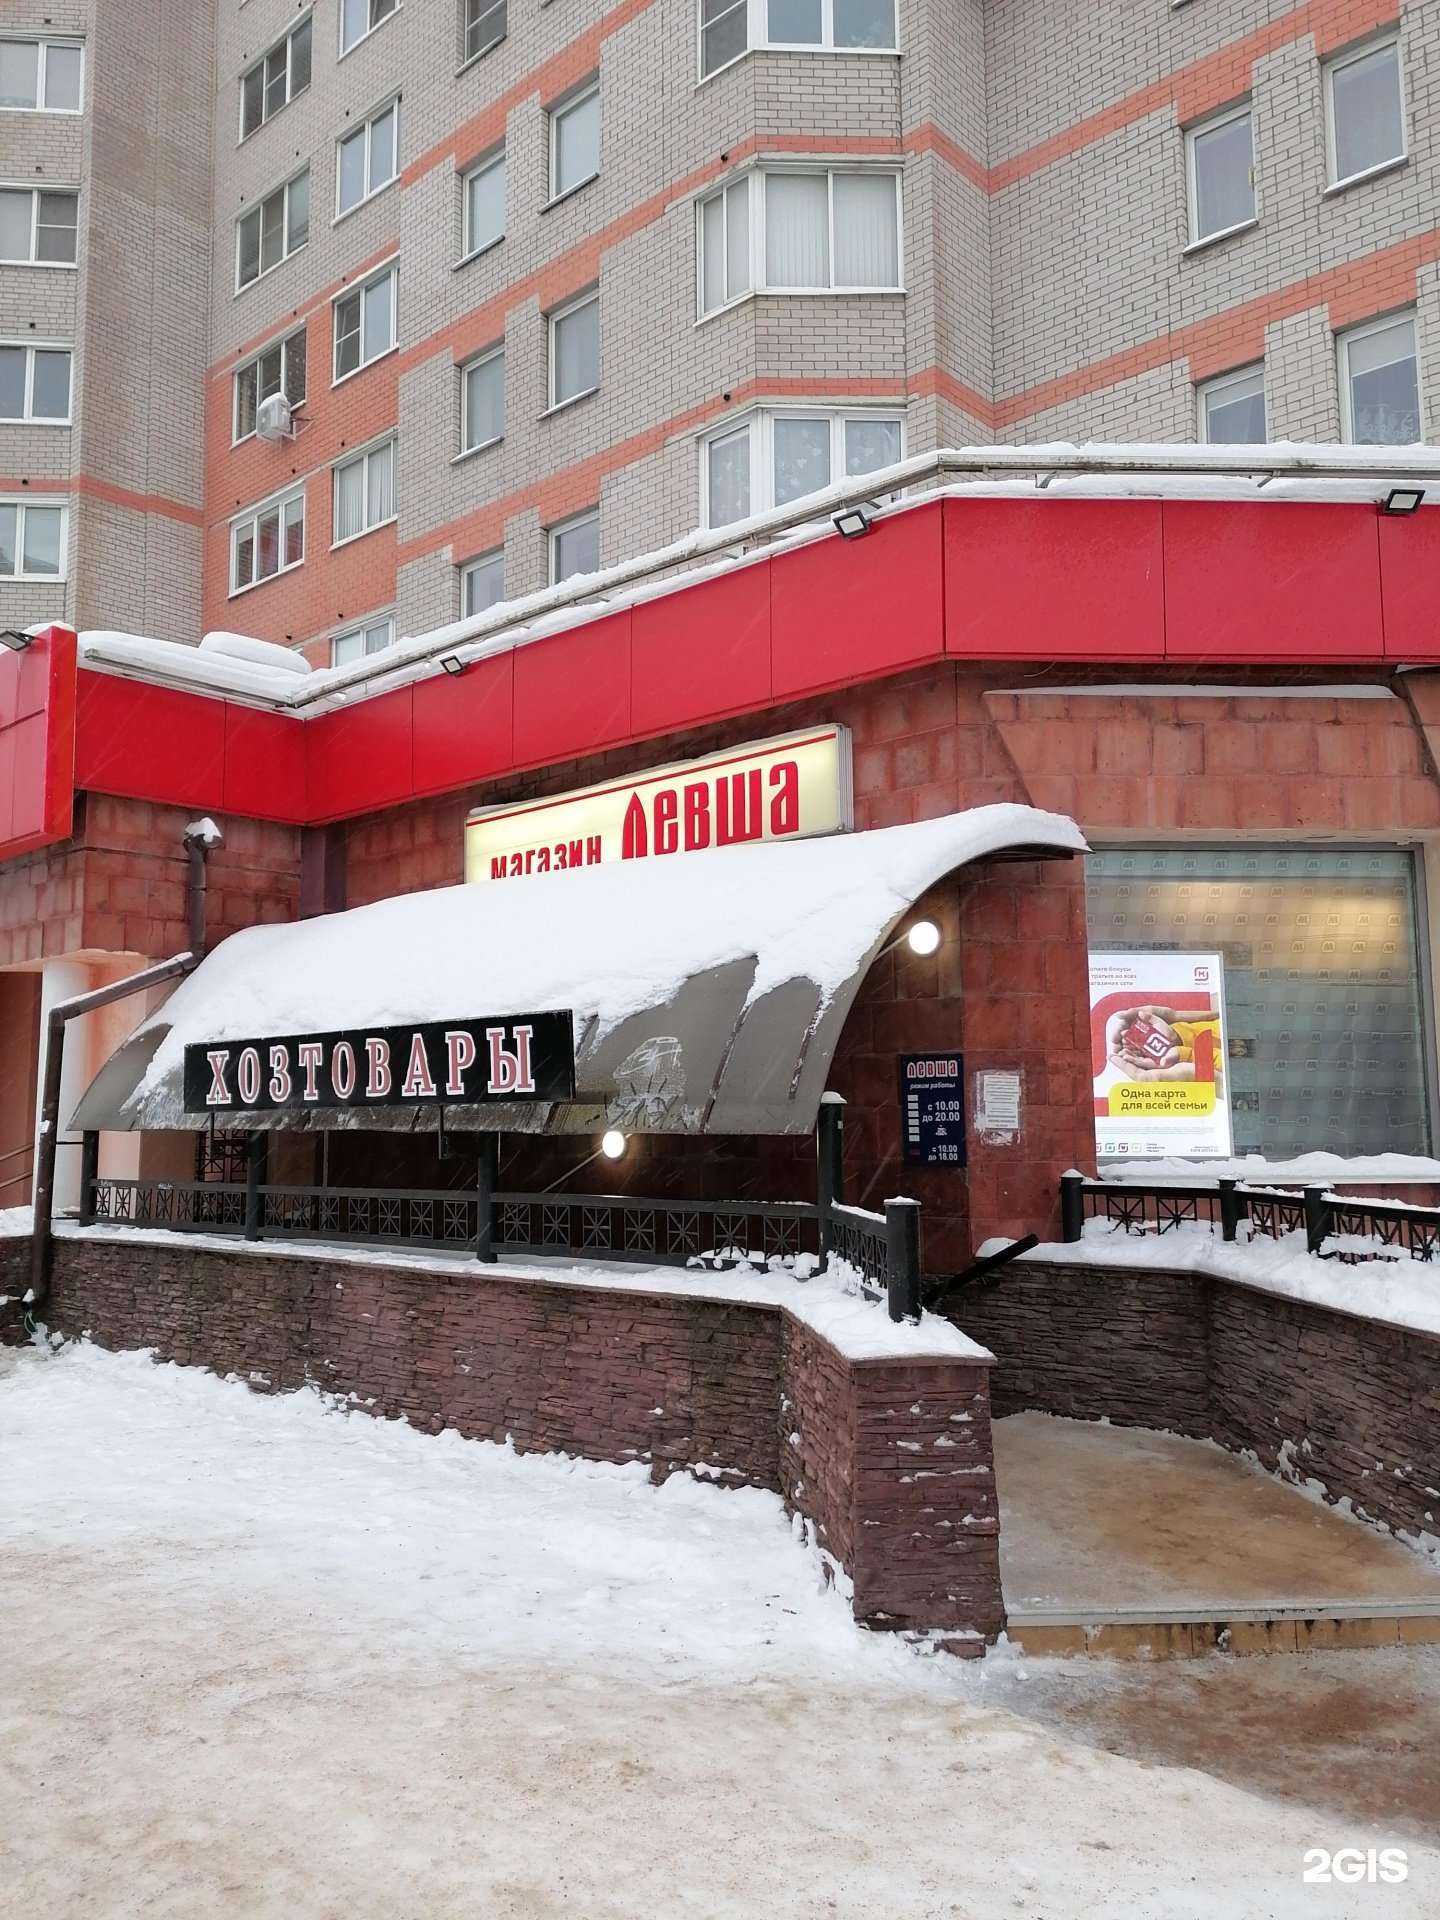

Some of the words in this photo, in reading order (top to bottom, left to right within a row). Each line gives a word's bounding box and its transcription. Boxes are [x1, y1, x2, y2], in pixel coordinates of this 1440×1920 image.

[490, 834, 602, 880] магазин
[621, 761, 800, 860] Левша
[206, 1025, 535, 1105] ХОЗТОВАРЫ
[1121, 1088, 1151, 1099] Одна
[1154, 1090, 1187, 1099] карта
[935, 1101, 960, 1111] 10.00
[1121, 1101, 1143, 1111] для
[1146, 1099, 1171, 1110] всей
[1174, 1101, 1208, 1110] семьи
[922, 1114, 933, 1123] до
[935, 1111, 960, 1121] 20.00
[938, 1144, 958, 1153] 10.00
[938, 1152, 958, 1161] 18.00
